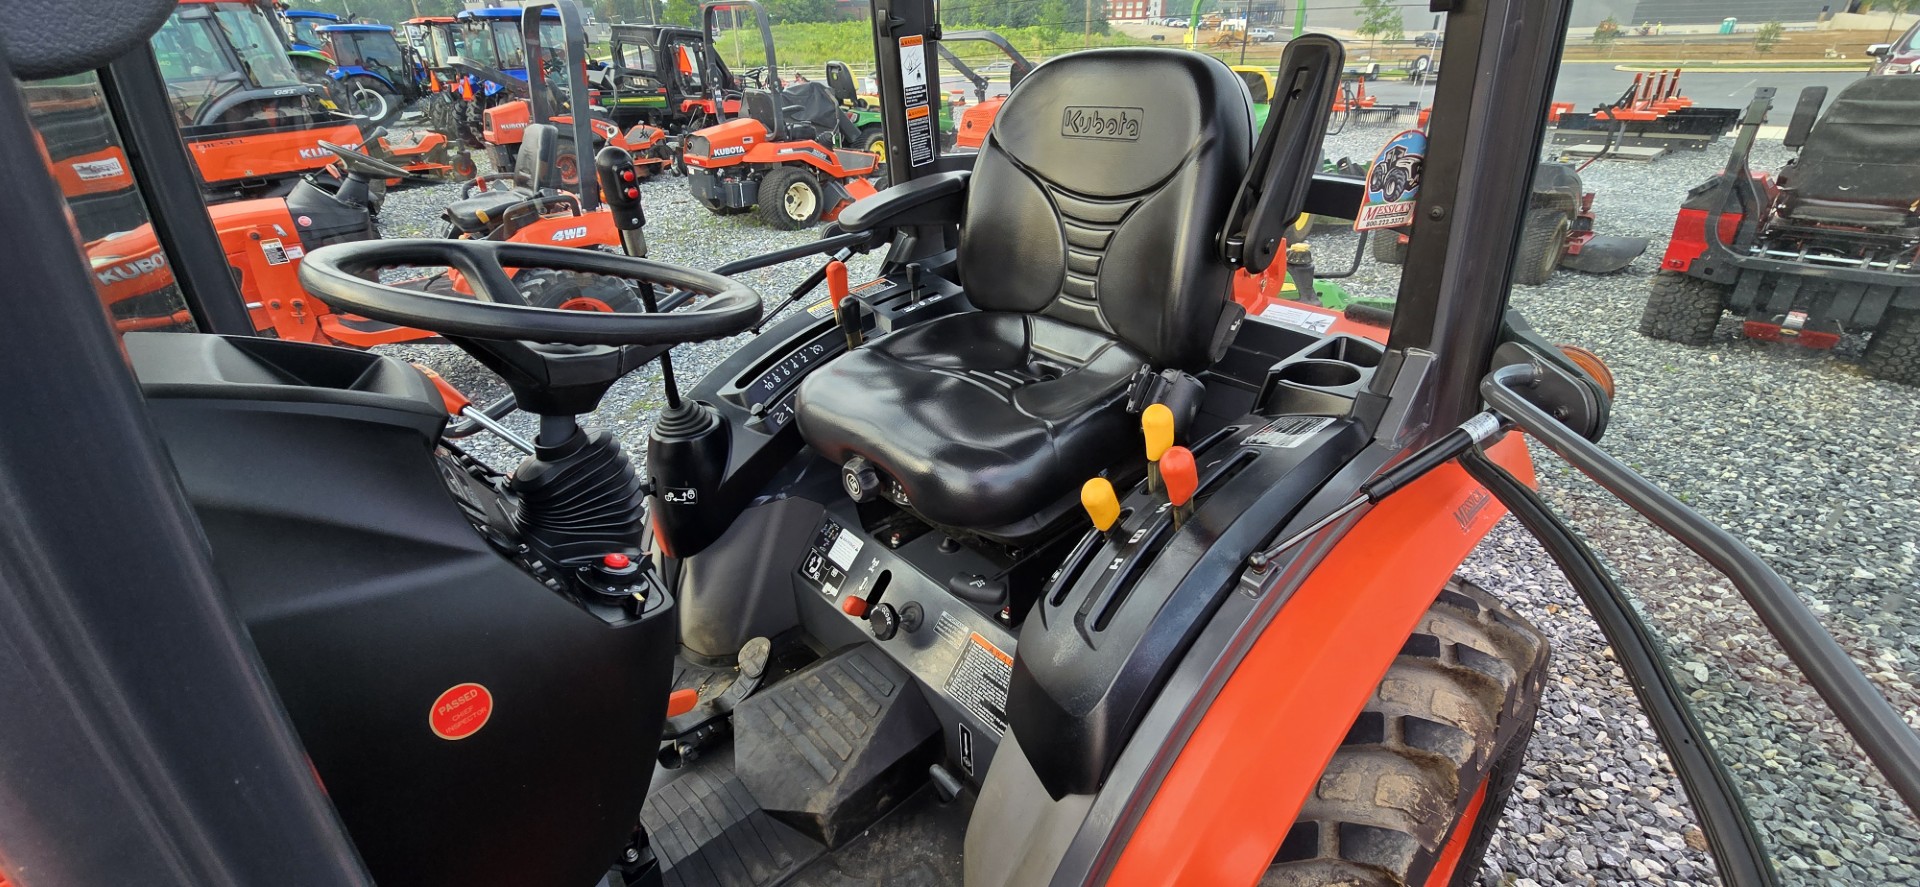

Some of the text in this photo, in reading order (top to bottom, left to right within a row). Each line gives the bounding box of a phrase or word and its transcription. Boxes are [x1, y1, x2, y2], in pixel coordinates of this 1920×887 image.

[1065, 110, 1139, 137] Kubota
[195, 139, 248, 150] DIESEL
[714, 145, 746, 157] KUBOTA
[552, 226, 587, 241] 4WD
[764, 381, 775, 391] 10
[774, 375, 781, 383] 8
[801, 355, 809, 363] 2
[438, 689, 478, 716] PASSED
[446, 706, 487, 734] INSPECTOR
